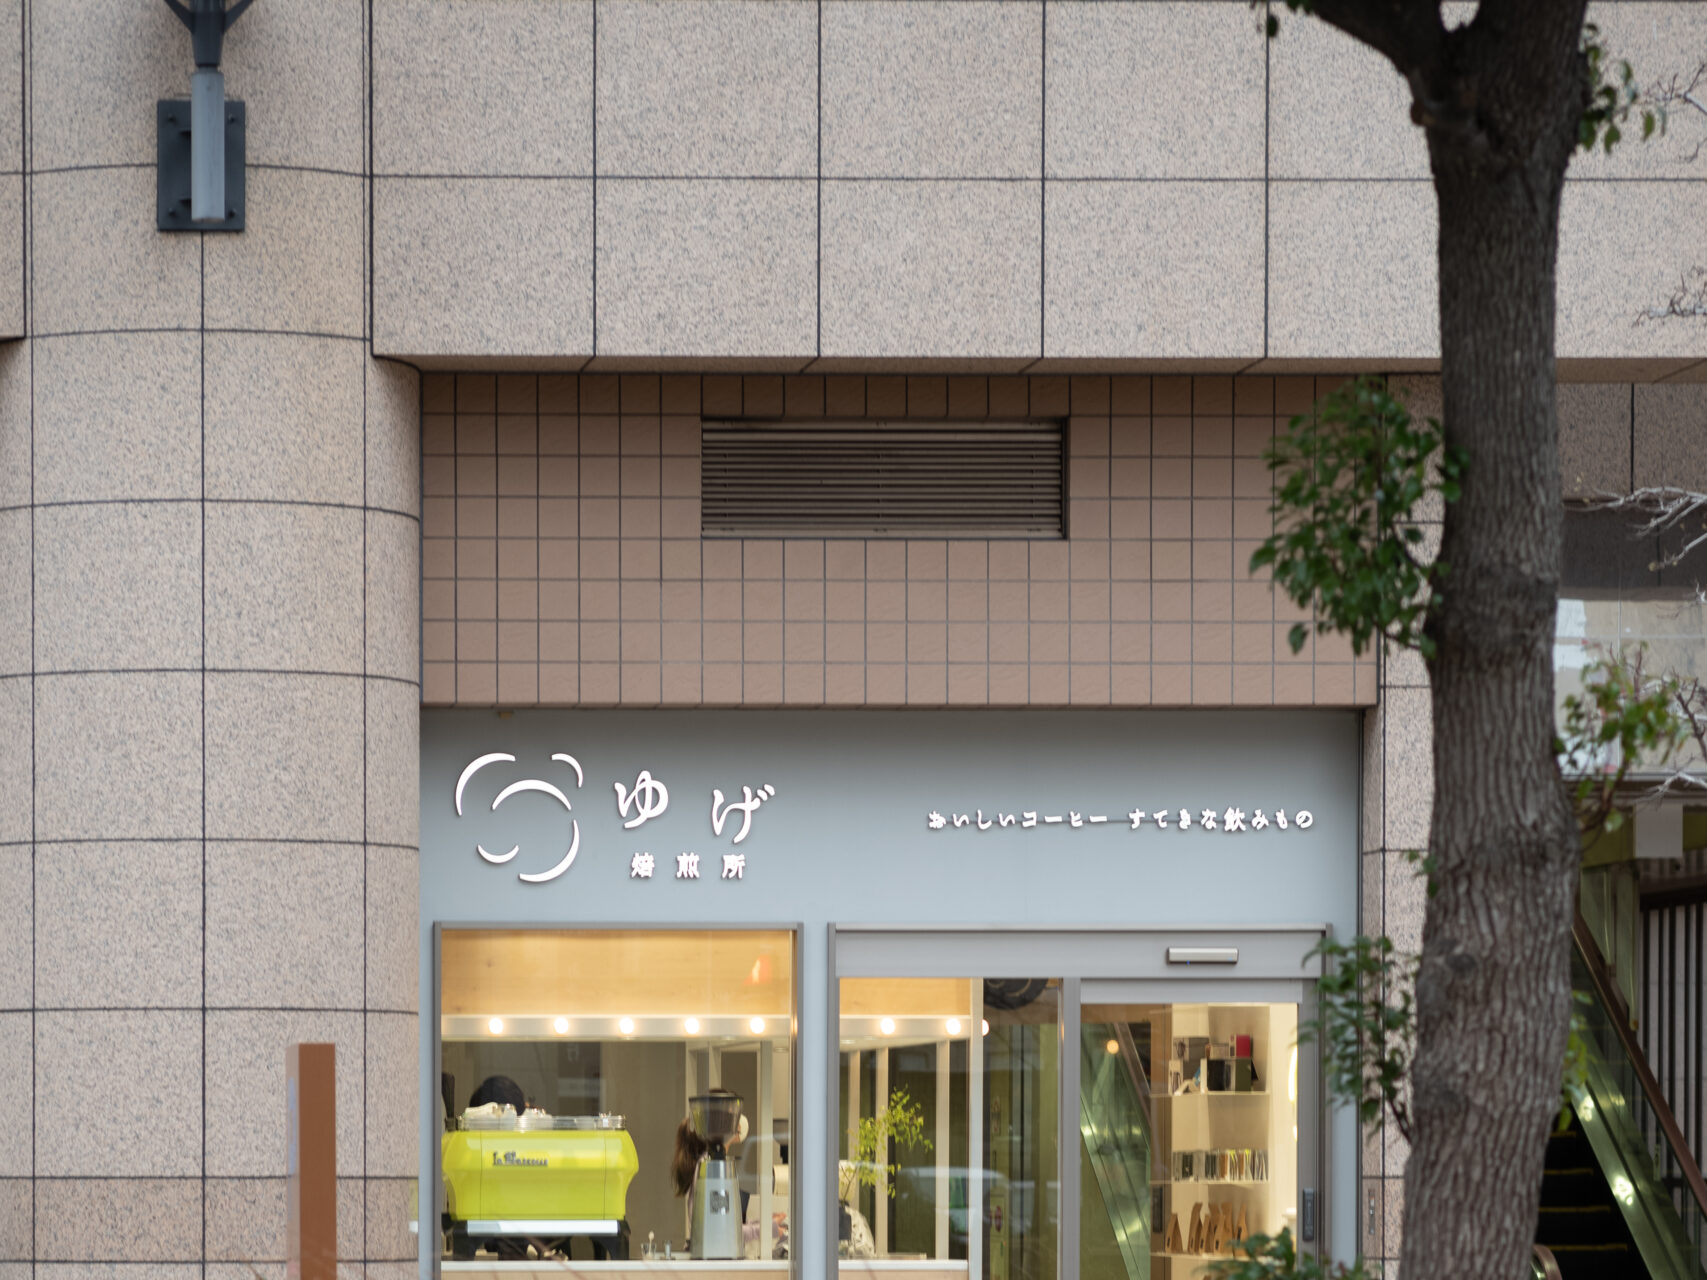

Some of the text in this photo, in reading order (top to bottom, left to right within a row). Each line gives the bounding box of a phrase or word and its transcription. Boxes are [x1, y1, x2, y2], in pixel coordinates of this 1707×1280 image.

[614, 770, 776, 844] ゆげ
[928, 807, 1313, 832] おいしいコーヒー すてきな飲みもの
[631, 852, 746, 879] 焙煎所
